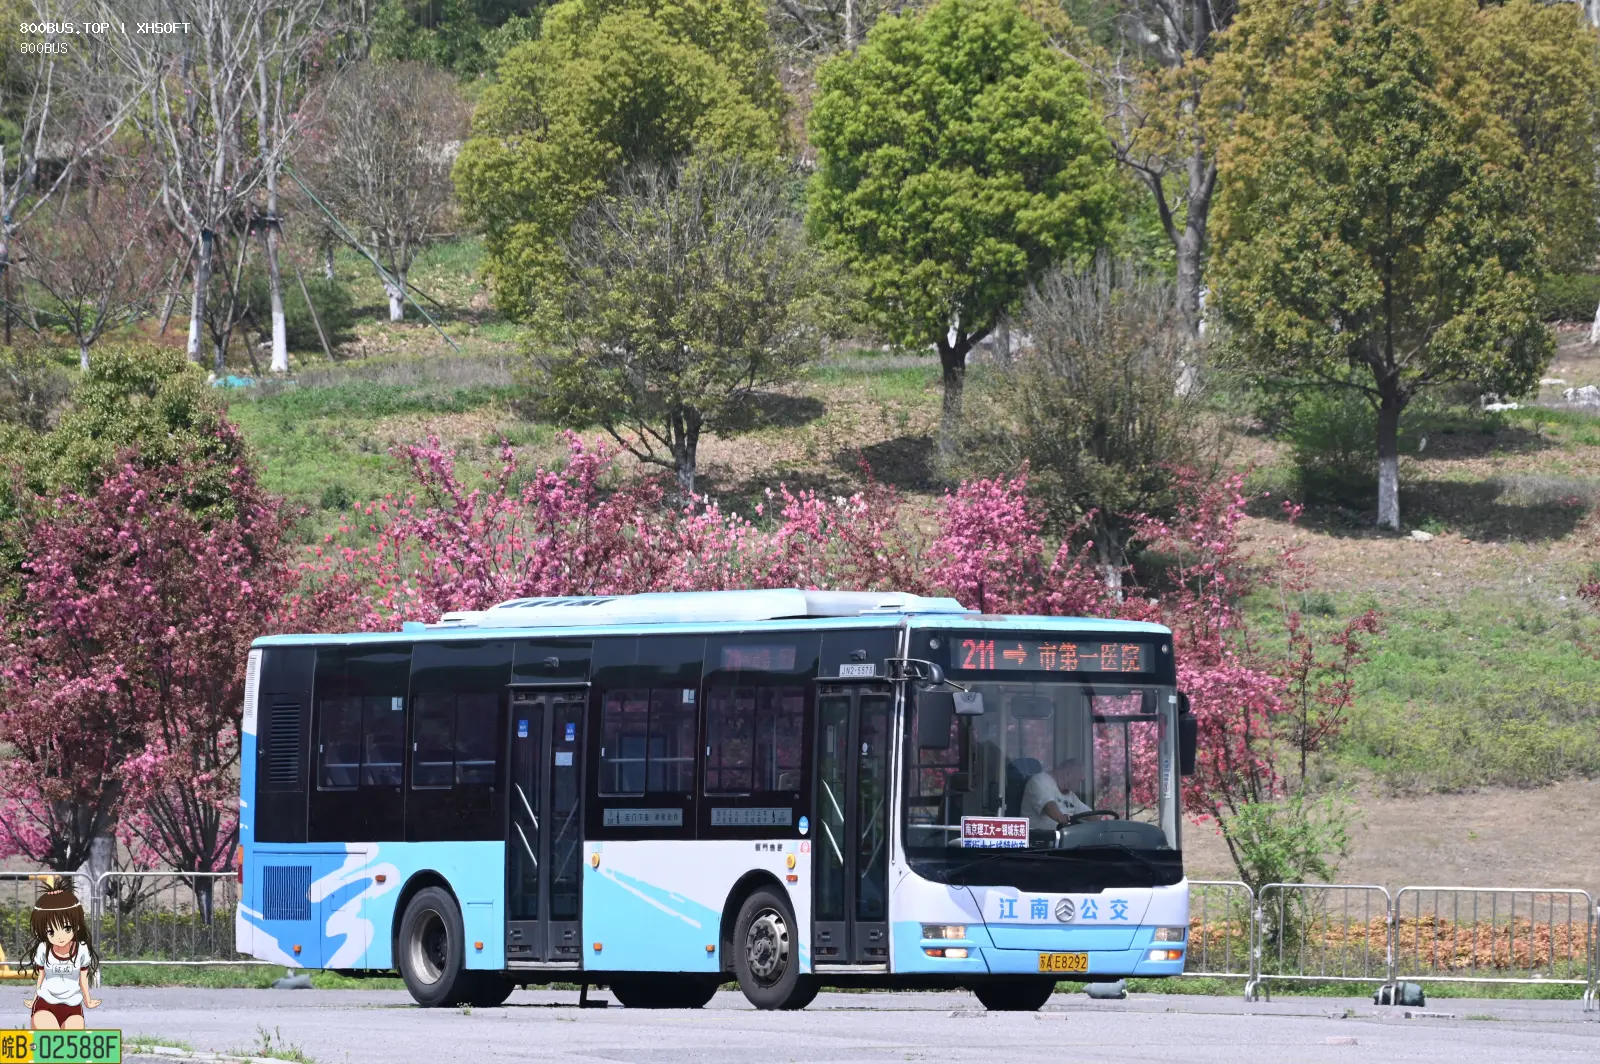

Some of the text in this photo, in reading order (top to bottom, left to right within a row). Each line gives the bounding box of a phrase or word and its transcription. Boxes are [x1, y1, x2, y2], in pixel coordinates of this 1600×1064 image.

[962, 639, 1141, 672] 211 市第一医院
